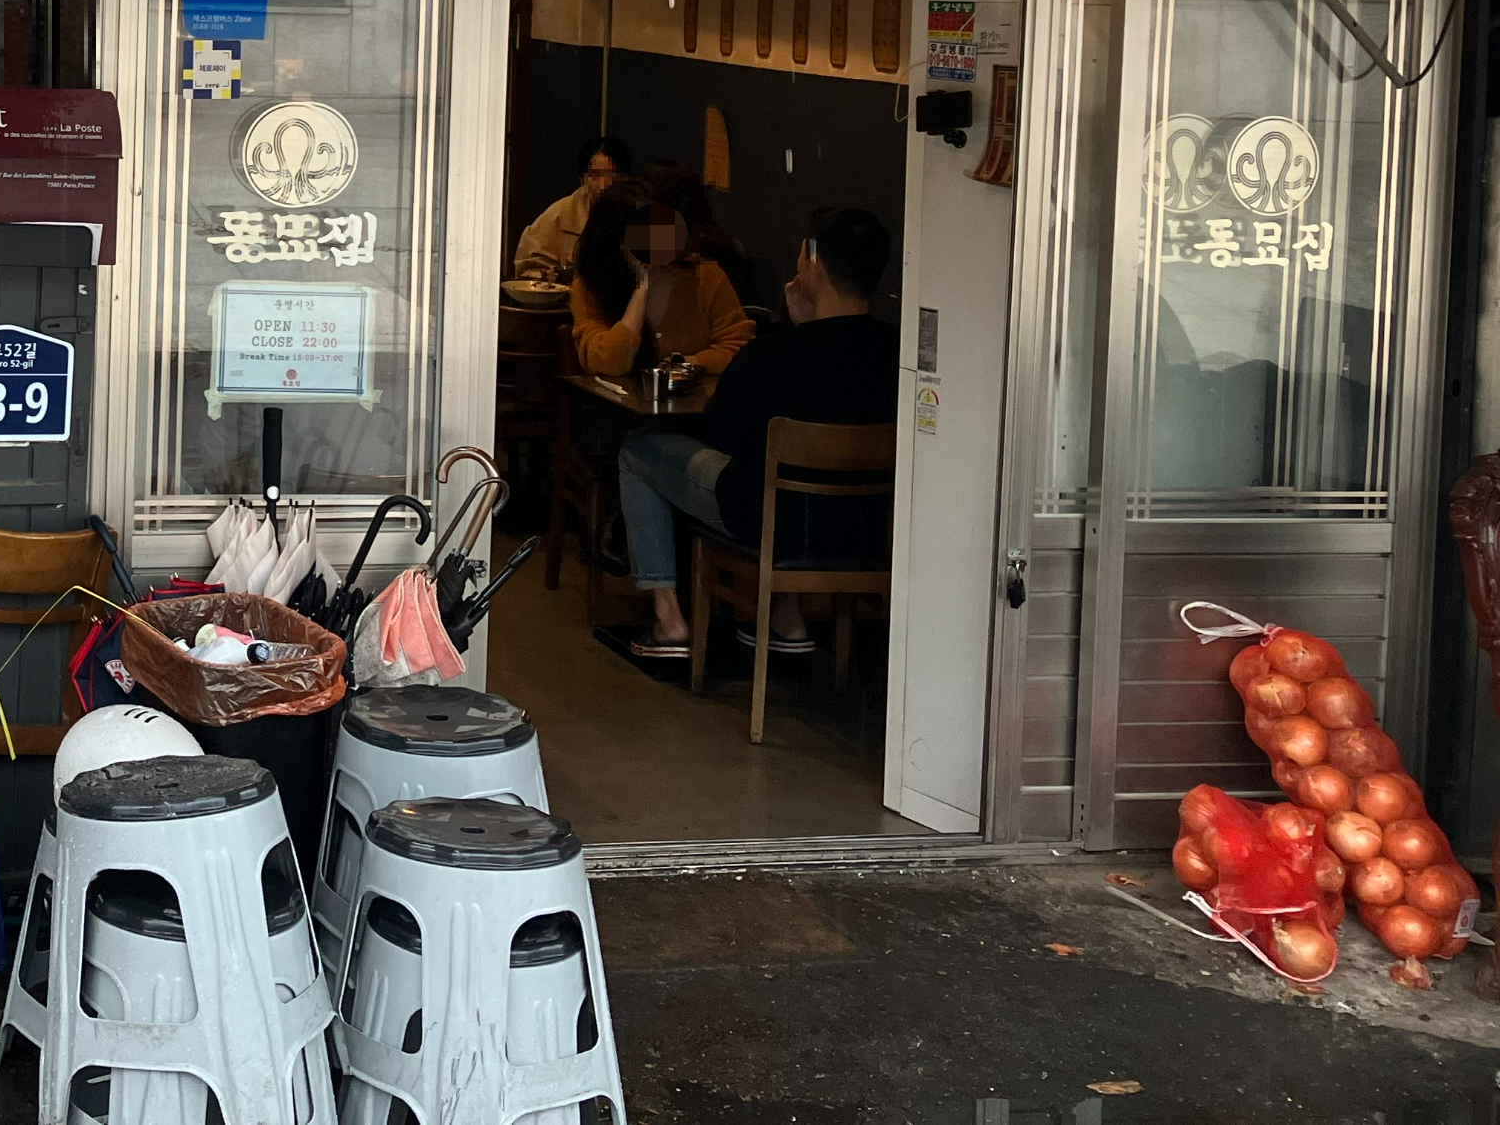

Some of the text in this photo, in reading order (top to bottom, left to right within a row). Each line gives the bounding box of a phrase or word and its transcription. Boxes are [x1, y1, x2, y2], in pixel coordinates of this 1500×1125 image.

[199, 64, 226, 72] 제로페이
[60, 124, 73, 132] La
[75, 124, 102, 133] Poste
[1193, 217, 1334, 272] 동묘집
[254, 320, 336, 333] OPEN 11:30
[251, 336, 337, 348] CLOSE 22:00
[240, 353, 265, 361] Break
[10, 360, 34, 368] 52-gil
